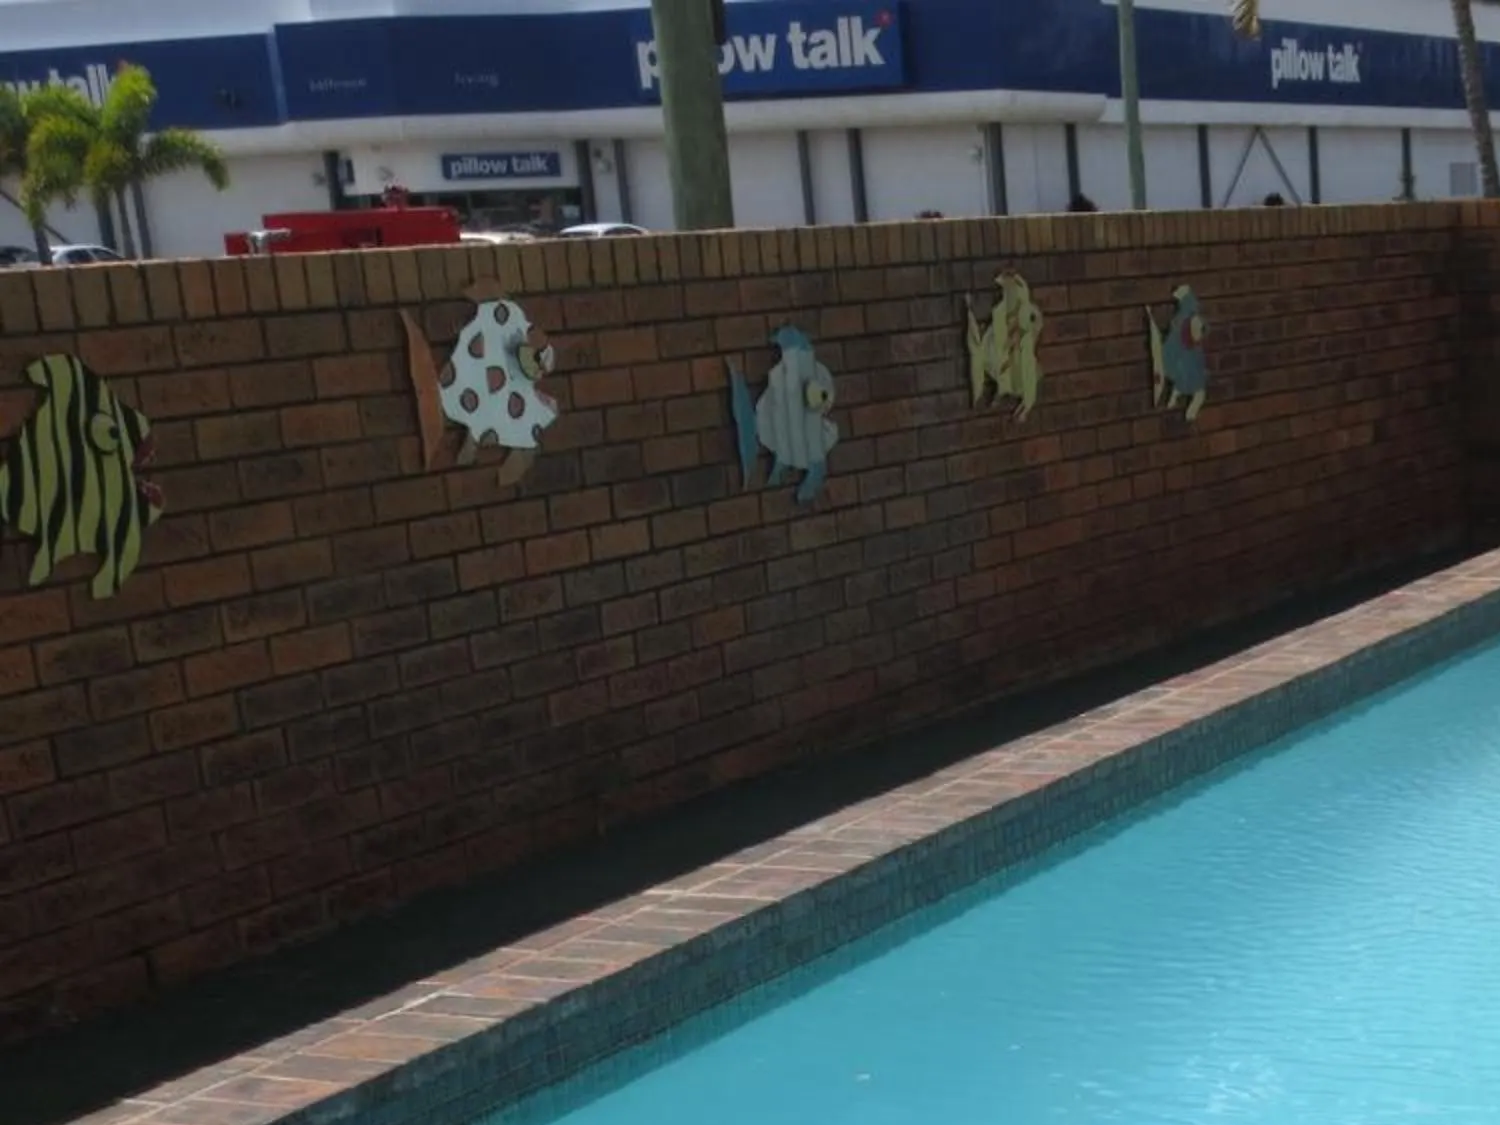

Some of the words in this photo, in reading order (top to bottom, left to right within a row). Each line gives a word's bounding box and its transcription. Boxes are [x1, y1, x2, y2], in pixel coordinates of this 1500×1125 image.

[637, 33, 777, 90] pow
[786, 16, 886, 70] talk
[1271, 37, 1324, 90] pillow
[1327, 43, 1361, 83] talk
[450, 156, 508, 180] pillow
[511, 153, 549, 174] talk
